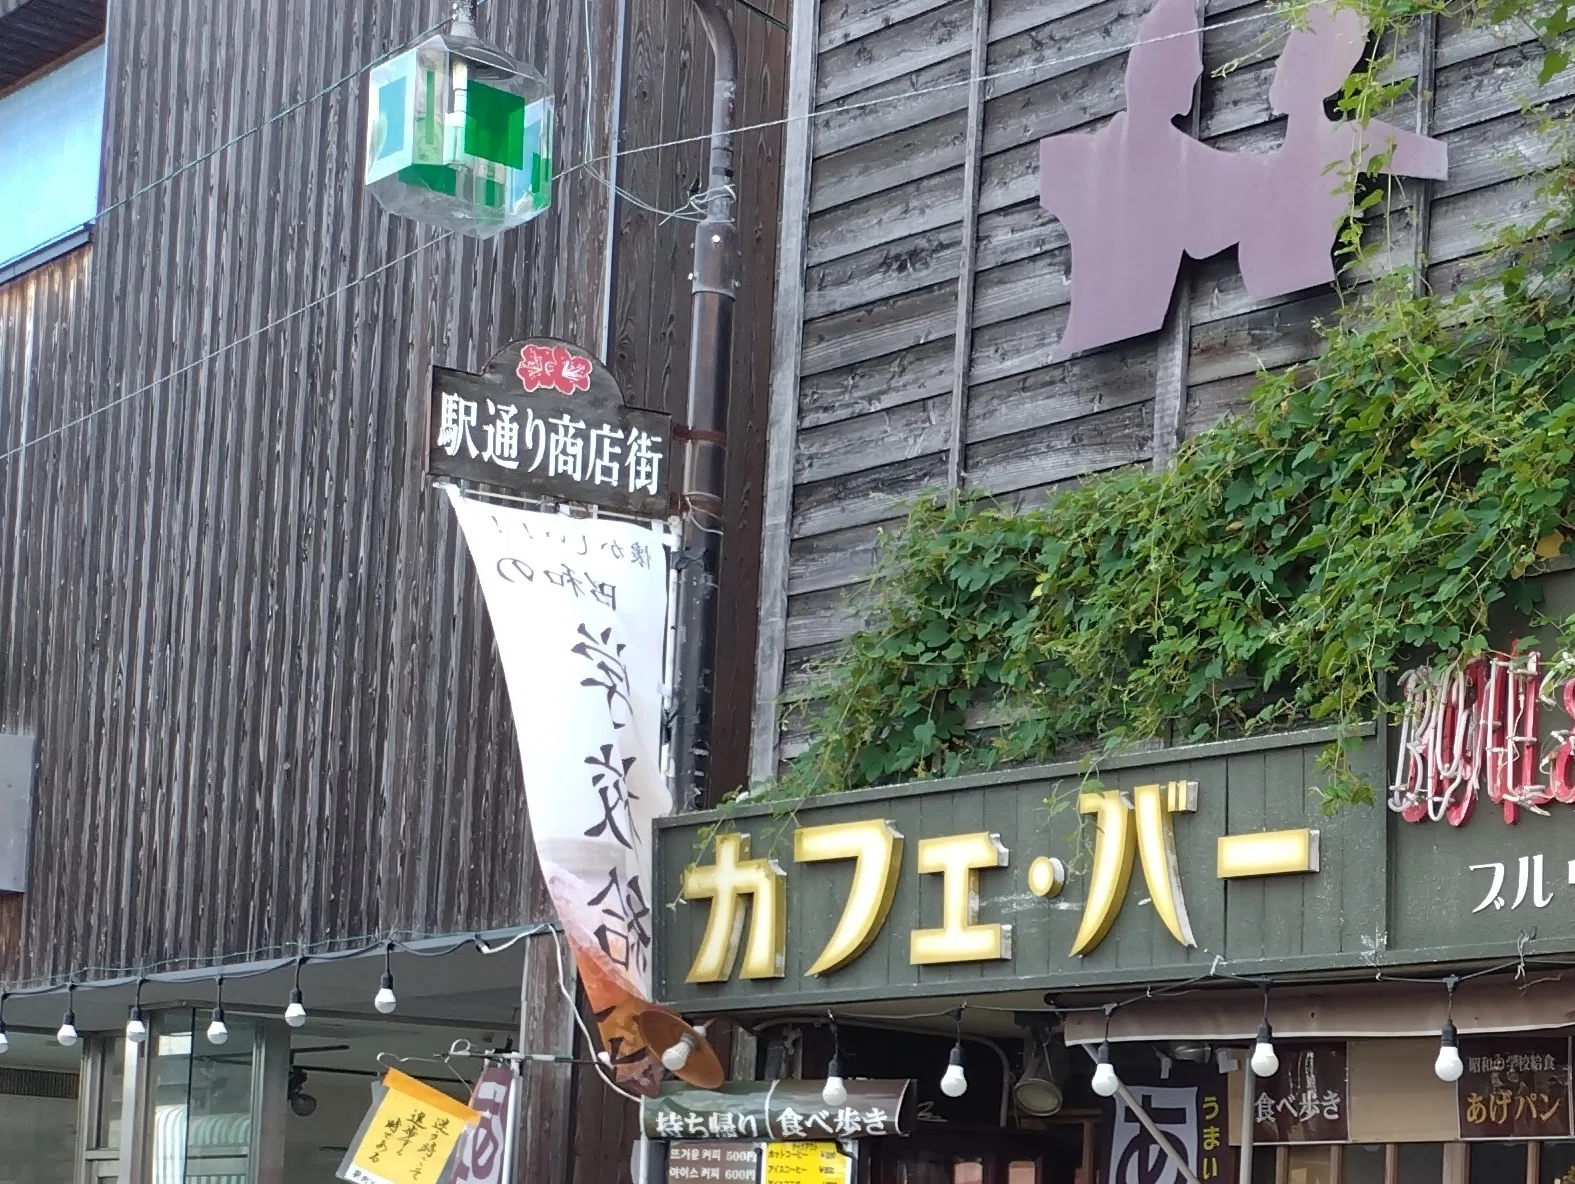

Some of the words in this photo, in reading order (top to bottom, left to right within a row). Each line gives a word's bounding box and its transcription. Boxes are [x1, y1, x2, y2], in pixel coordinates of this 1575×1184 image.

[435, 391, 665, 496] 駅通り商店街
[684, 780, 1321, 984] カフェ・バー
[1468, 1054, 1555, 1073] 昭和の学校給食
[656, 1111, 758, 1138] 持ち帰り
[777, 1107, 888, 1140] 食べ歩き
[1254, 1090, 1342, 1124] 食べ歩き
[1466, 1091, 1560, 1125] あげパン
[702, 1149, 720, 1161] 커피
[701, 1167, 719, 1179] 커피
